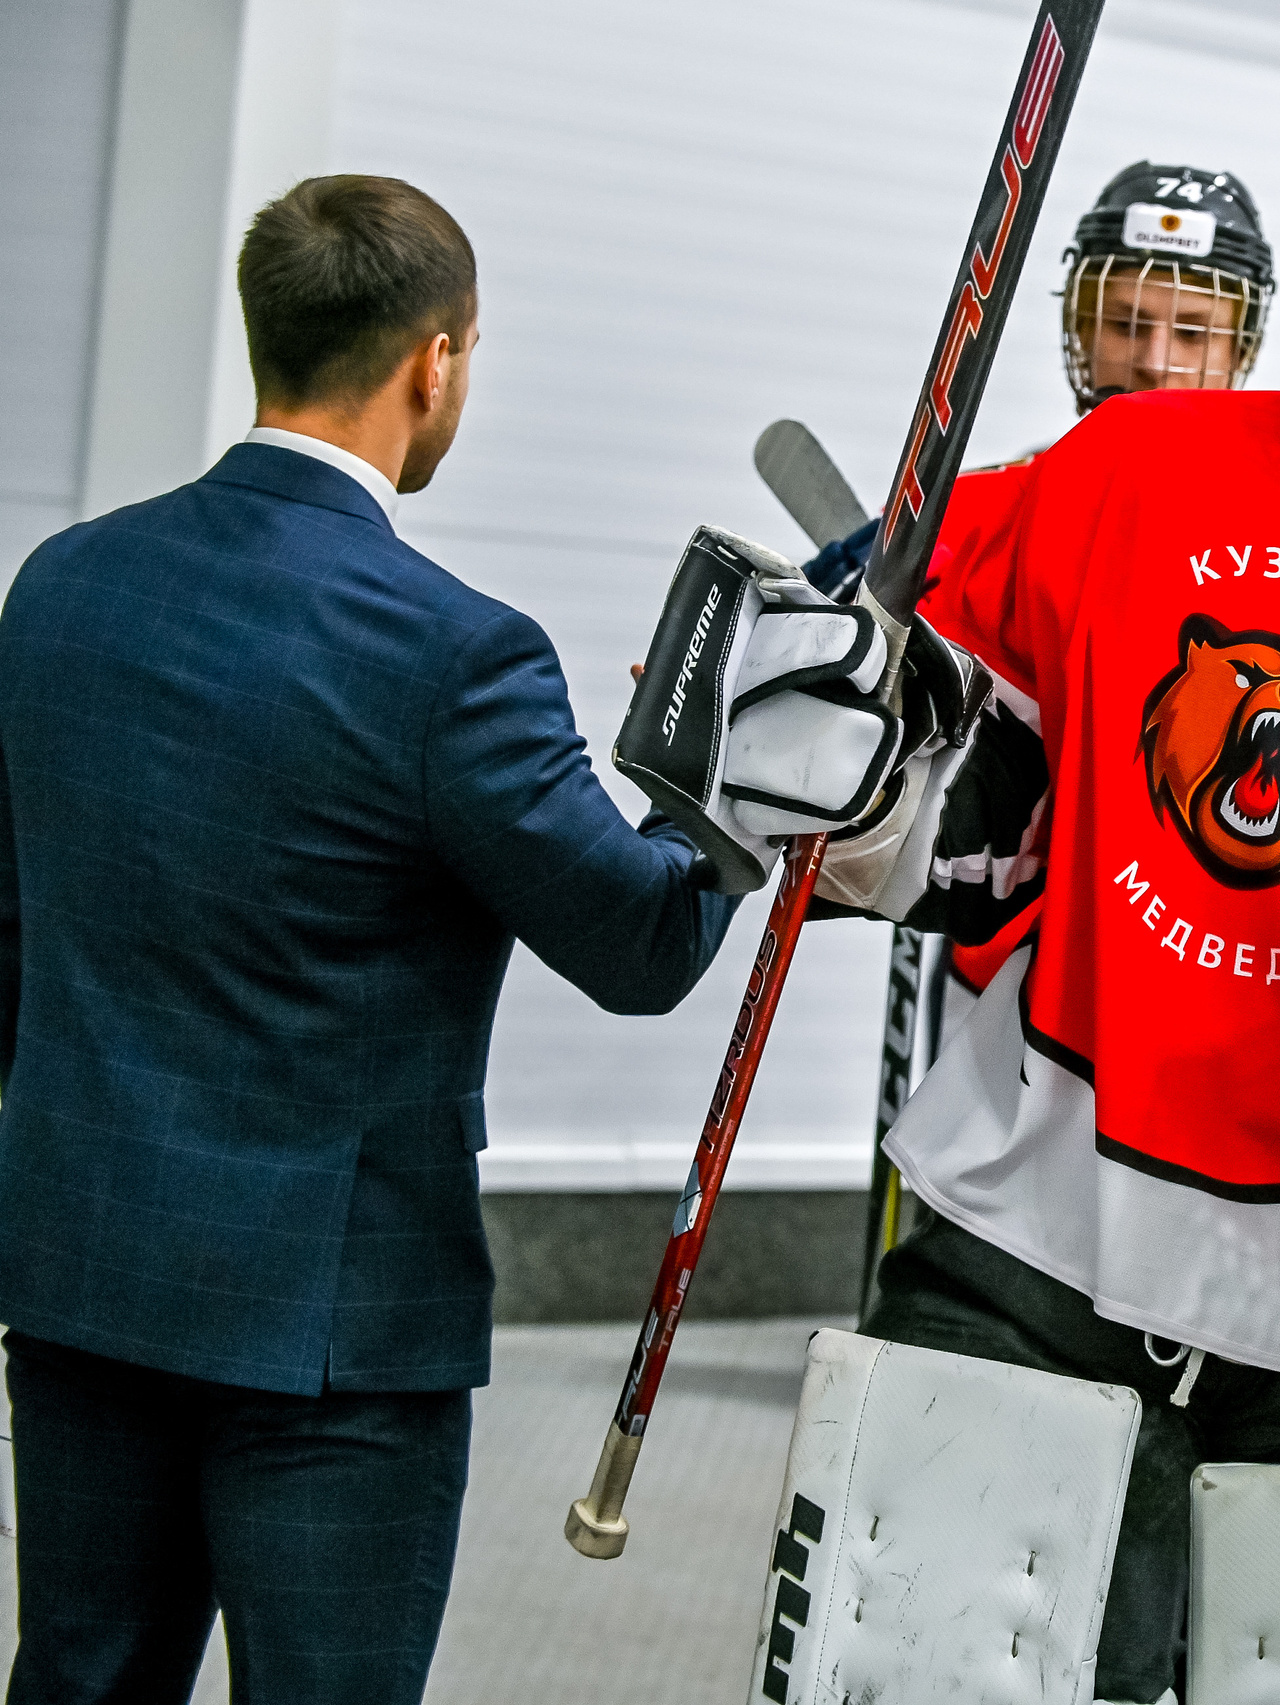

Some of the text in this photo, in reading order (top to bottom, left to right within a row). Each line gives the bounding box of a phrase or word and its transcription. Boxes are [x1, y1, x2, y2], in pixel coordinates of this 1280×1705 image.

[1135, 232, 1200, 249] OLIMPBET
[1154, 176, 1204, 203] 74
[883, 13, 1066, 555] TRUE
[878, 927, 922, 1128] CCM
[658, 1268, 692, 1354] TRUE
[617, 1307, 659, 1427] RUE
